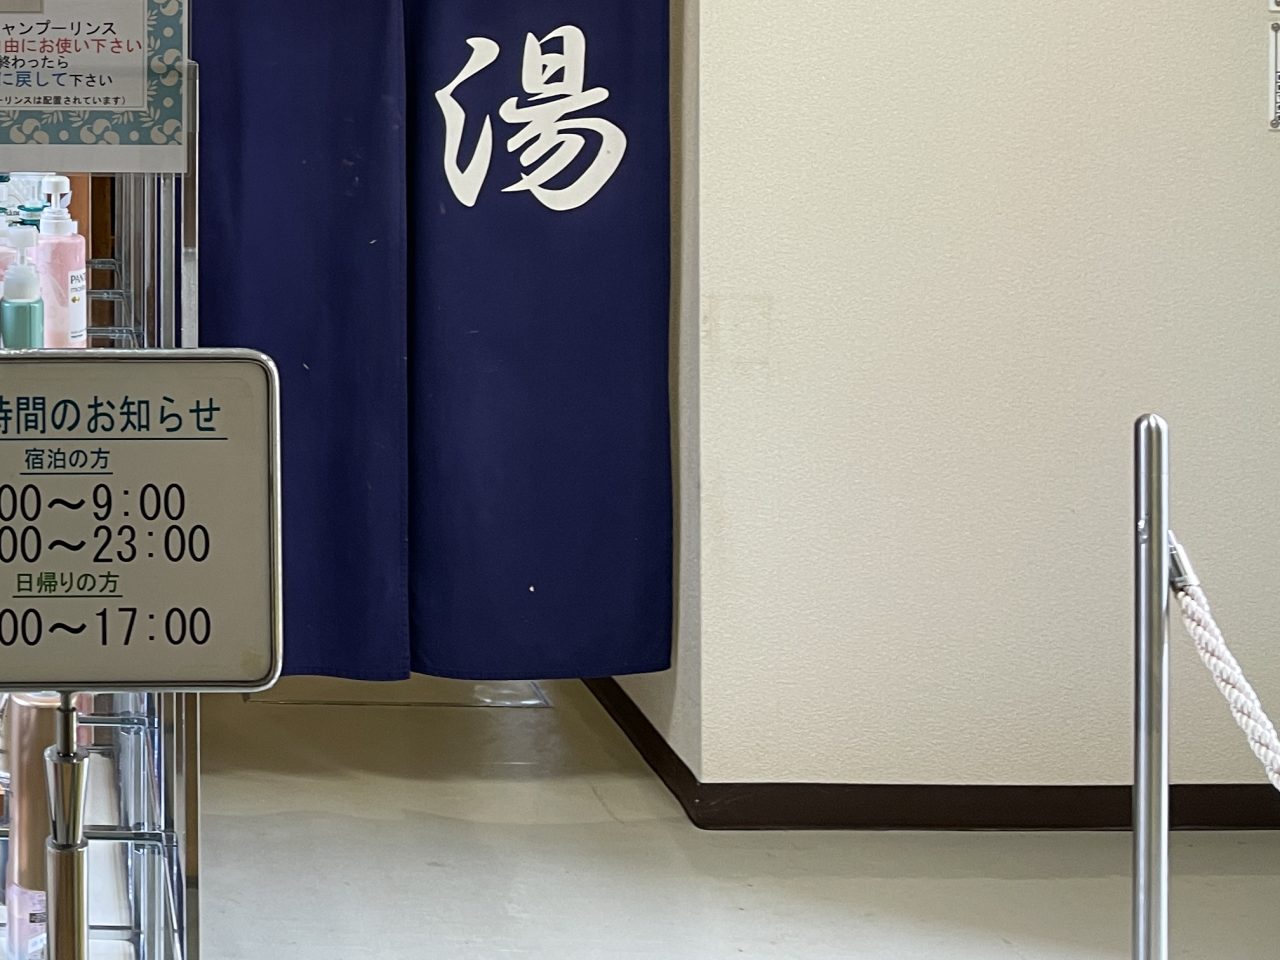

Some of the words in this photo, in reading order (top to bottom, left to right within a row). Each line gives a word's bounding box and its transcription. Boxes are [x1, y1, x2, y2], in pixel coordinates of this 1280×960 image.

[435, 25, 627, 211] 湯
[24, 448, 111, 470] 宿泊の方
[17, 571, 120, 594] 日帰りの方
